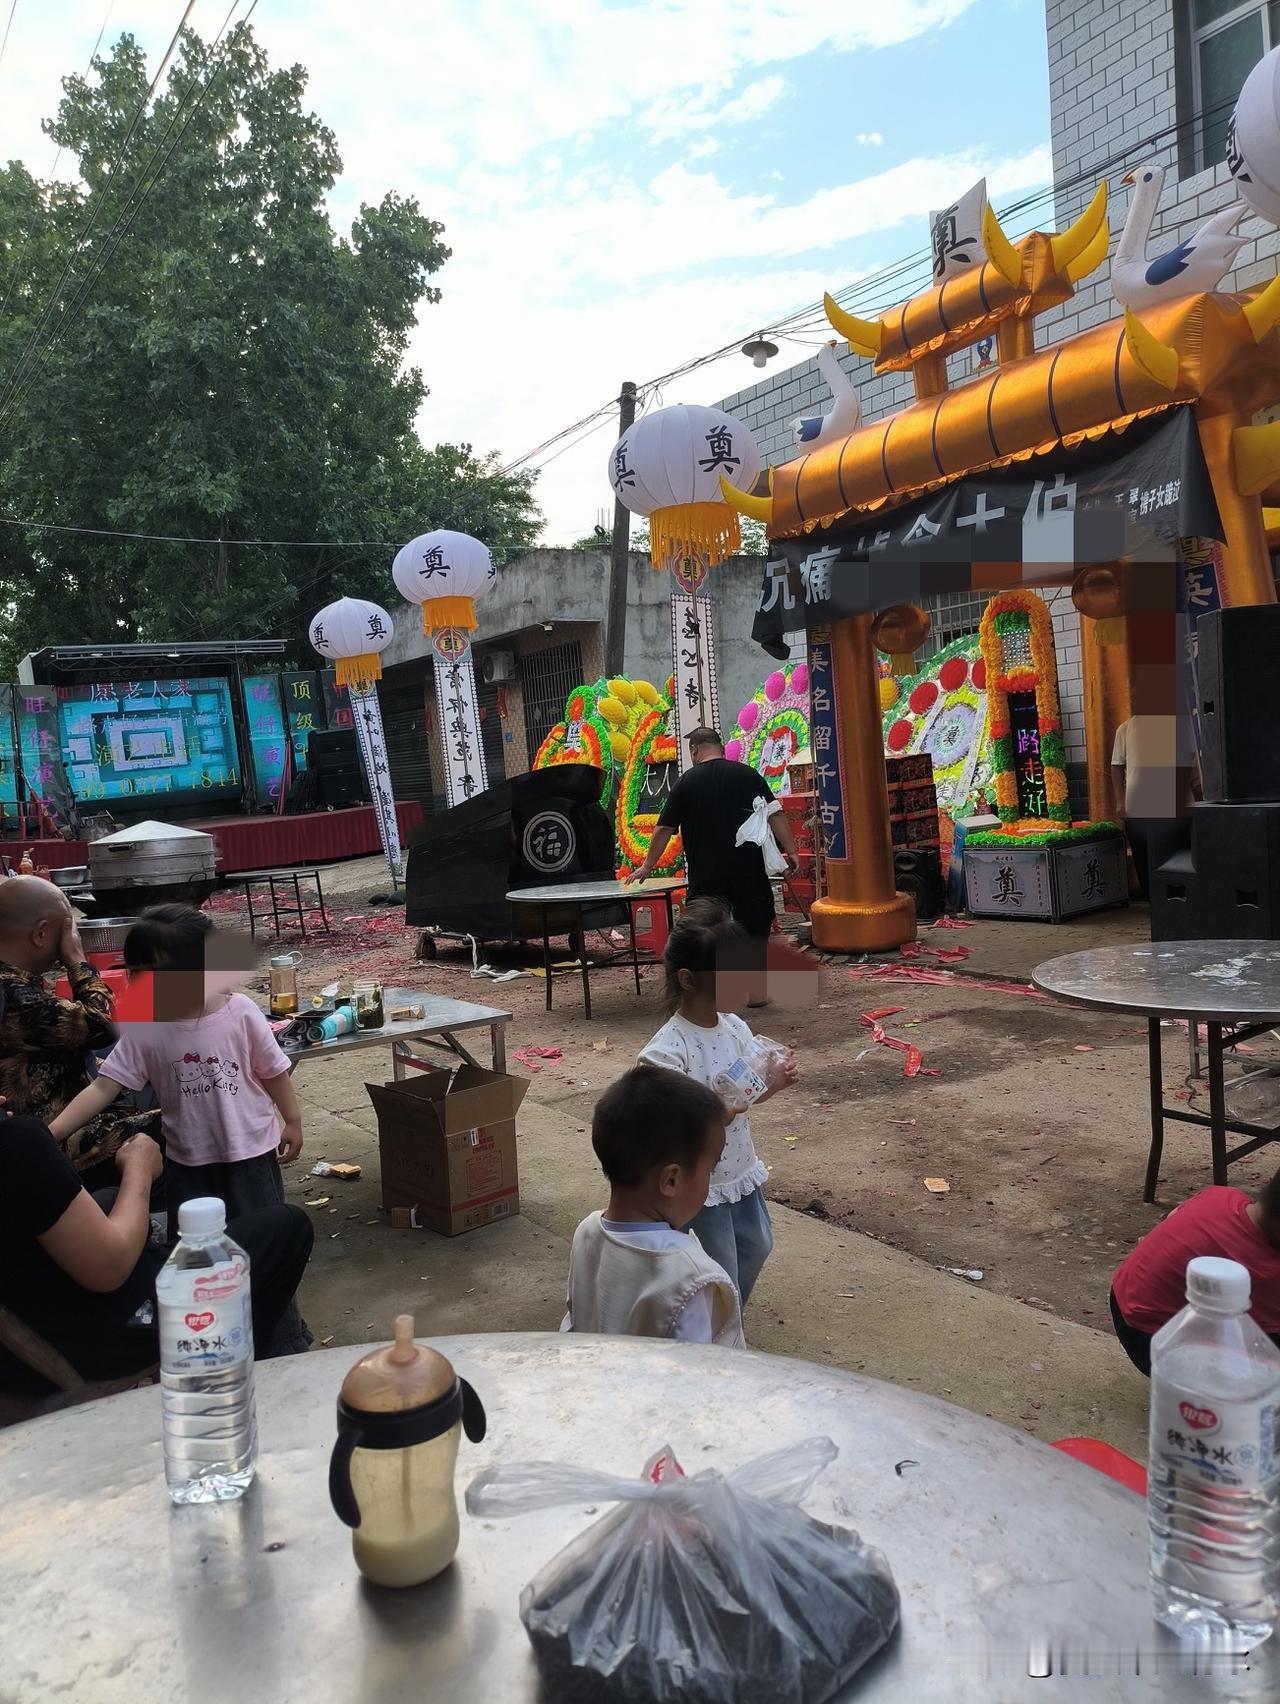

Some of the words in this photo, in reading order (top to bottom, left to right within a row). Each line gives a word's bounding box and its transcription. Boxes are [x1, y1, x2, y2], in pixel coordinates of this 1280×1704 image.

[931, 205, 977, 277] 奠
[698, 425, 741, 475] 奠
[419, 545, 451, 579] 奠
[314, 622, 330, 650] 奠
[366, 614, 387, 640] 奠
[810, 647, 840, 825] 美名留千古
[532, 825, 561, 859] 福
[992, 865, 1024, 905] 奠
[181, 1083, 212, 1099] Hello
[213, 1077, 239, 1096] Kitty
